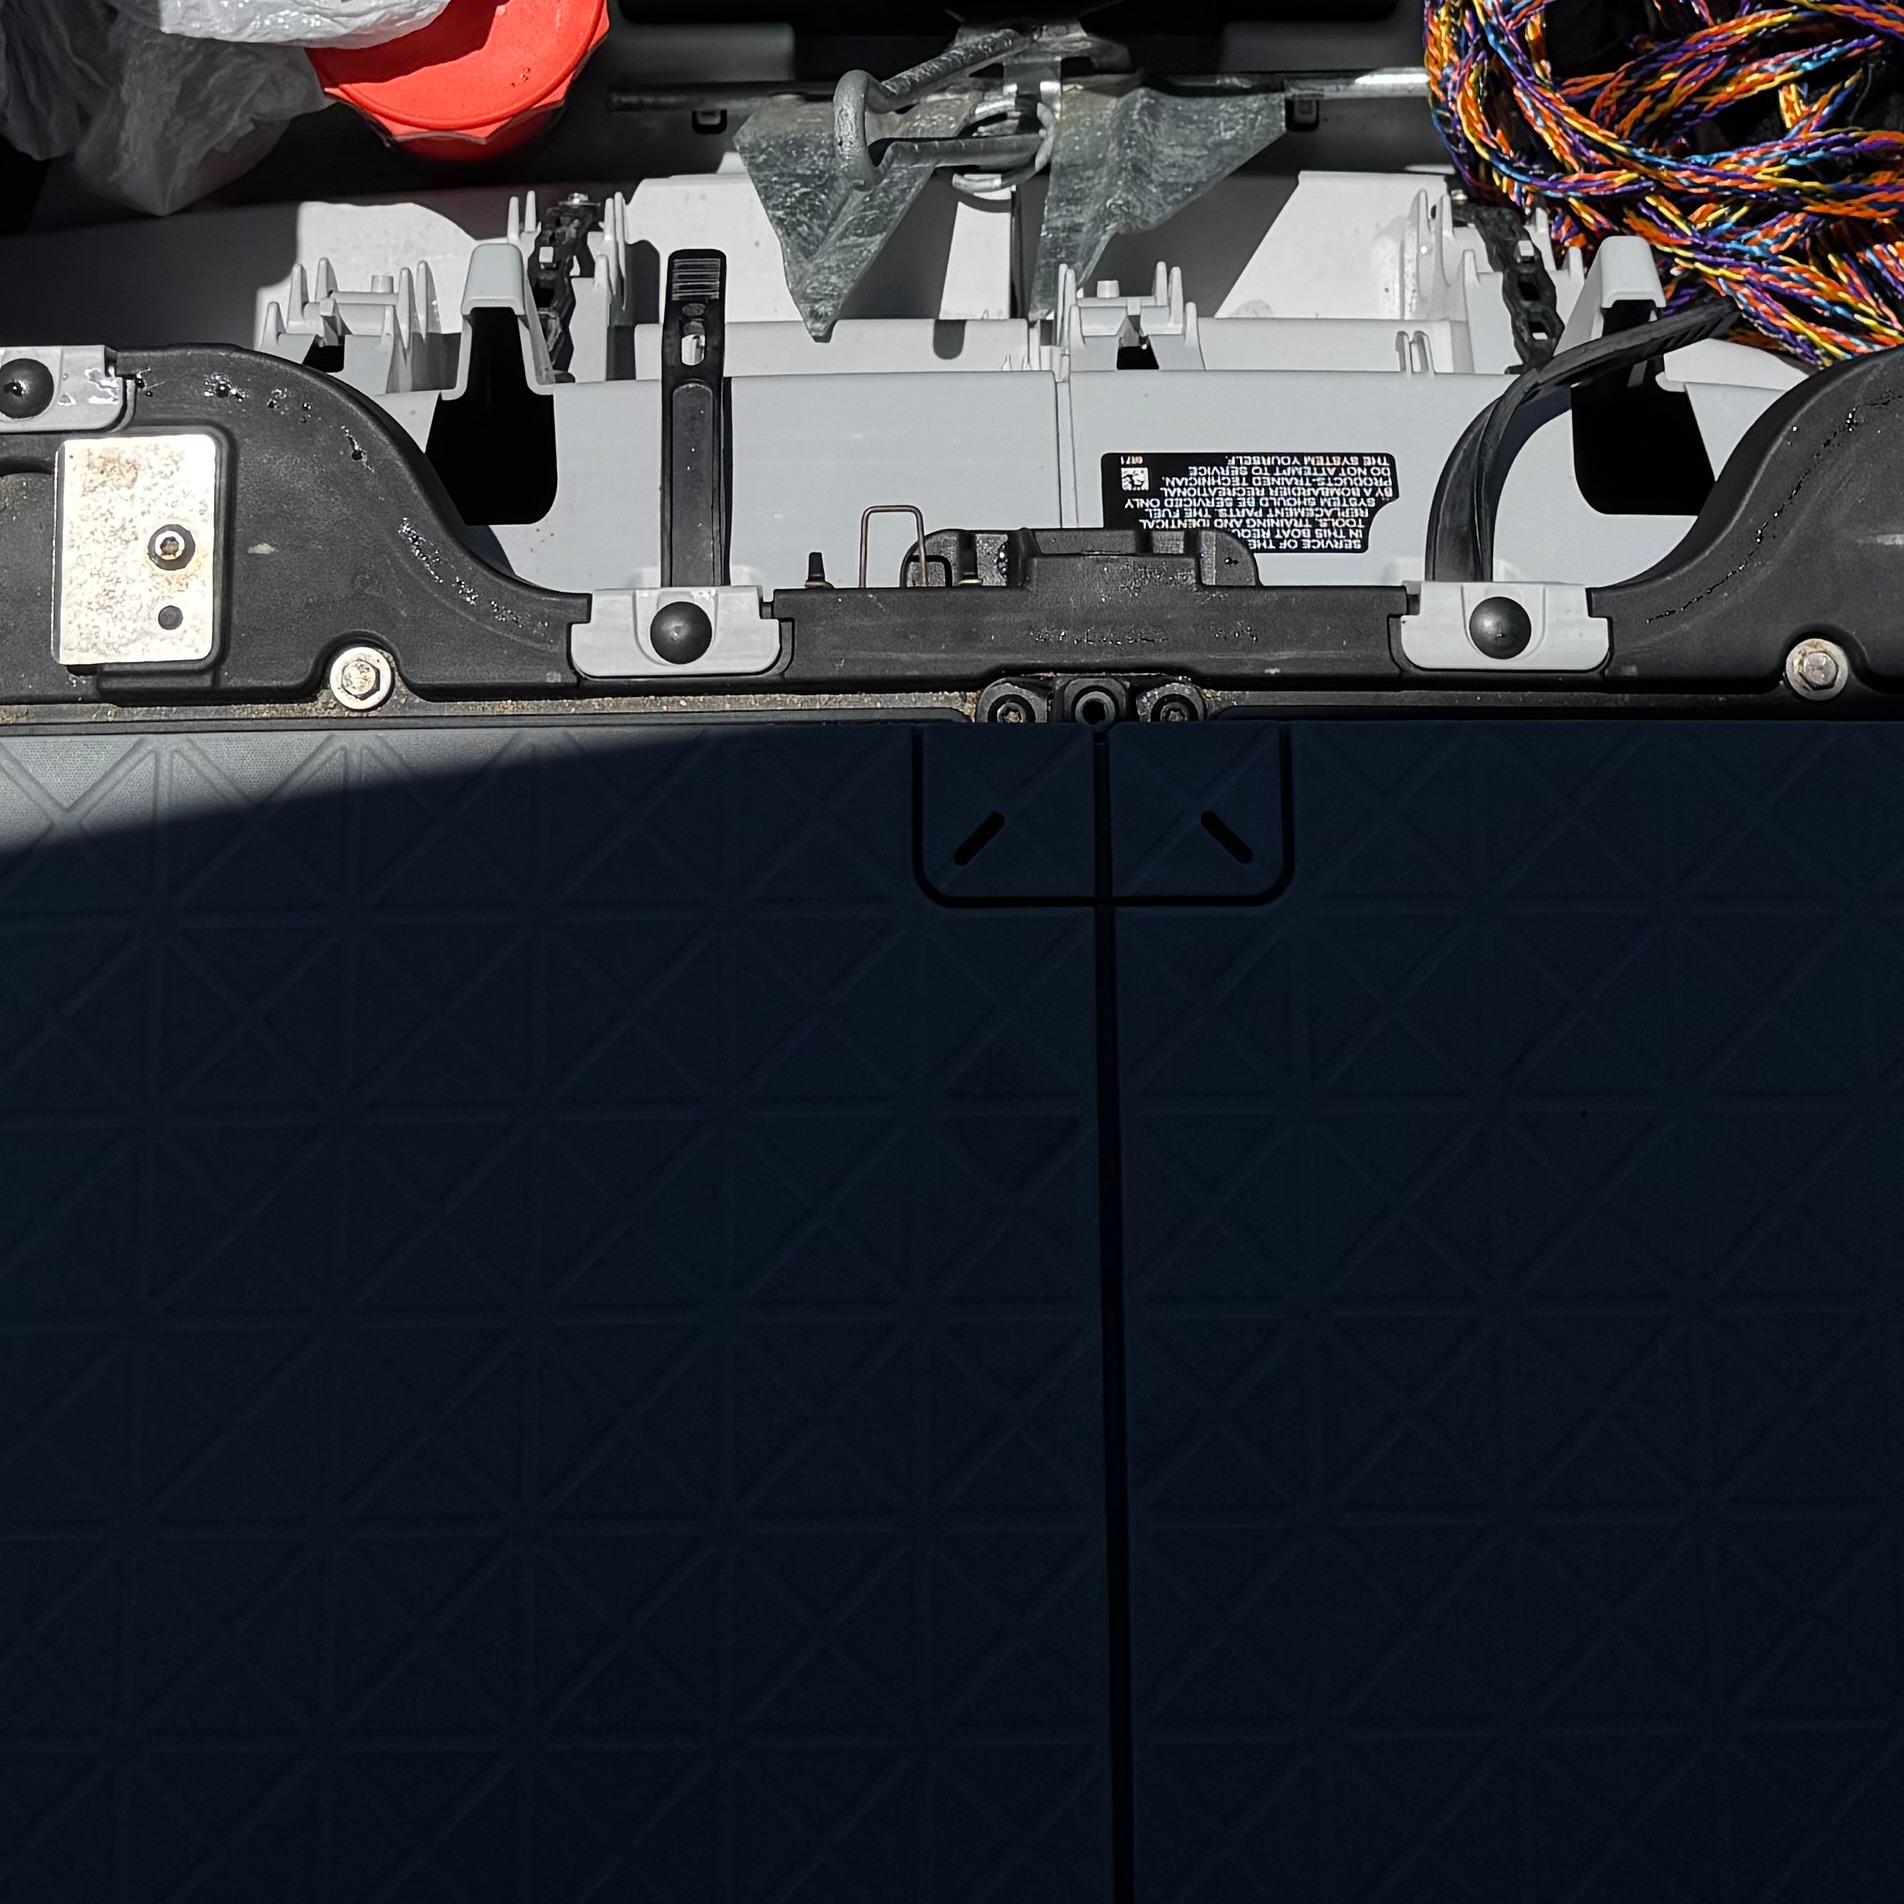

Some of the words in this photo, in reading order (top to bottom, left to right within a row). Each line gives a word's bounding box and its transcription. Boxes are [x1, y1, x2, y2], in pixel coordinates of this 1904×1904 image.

[1225, 456, 1301, 466] YOURSELF.
[1304, 456, 1358, 466] SYSTEM
[1363, 456, 1389, 466] THE
[1188, 466, 1248, 476] SERVICE
[1252, 466, 1270, 475] TO
[1274, 466, 1336, 476] ATTEMPT
[1339, 467, 1367, 476] NOT
[1371, 467, 1390, 476] DO
[1252, 477, 1392, 486] PRODUCTS-TRAINED
[1160, 487, 1265, 497] RECREATIONAL
[1269, 487, 1360, 496] BOMBARDIER
[1363, 487, 1372, 496] A
[1376, 487, 1392, 497] BY
[1125, 498, 1160, 508] ONLY
[1164, 498, 1233, 507] SERVICED
[1237, 497, 1255, 507] BE
[1259, 497, 1316, 507] SHOULD
[1320, 497, 1375, 507] SYSTEM
[1145, 508, 1179, 518] FUEL
[1184, 508, 1211, 517] THE
[1267, 508, 1368, 517] REPLACEMENT
[1139, 519, 1210, 528] IDENTICAL
[1214, 519, 1243, 528] AND
[1246, 518, 1312, 527] TRAINING
[1232, 529, 1270, 538] REQU
[1275, 529, 1310, 538] BOAT
[1315, 529, 1345, 538] THIS
[1349, 529, 1362, 538] IN
[1248, 539, 1275, 549] THE
[1279, 539, 1298, 549] OF
[1301, 539, 1361, 549] SERVICE
